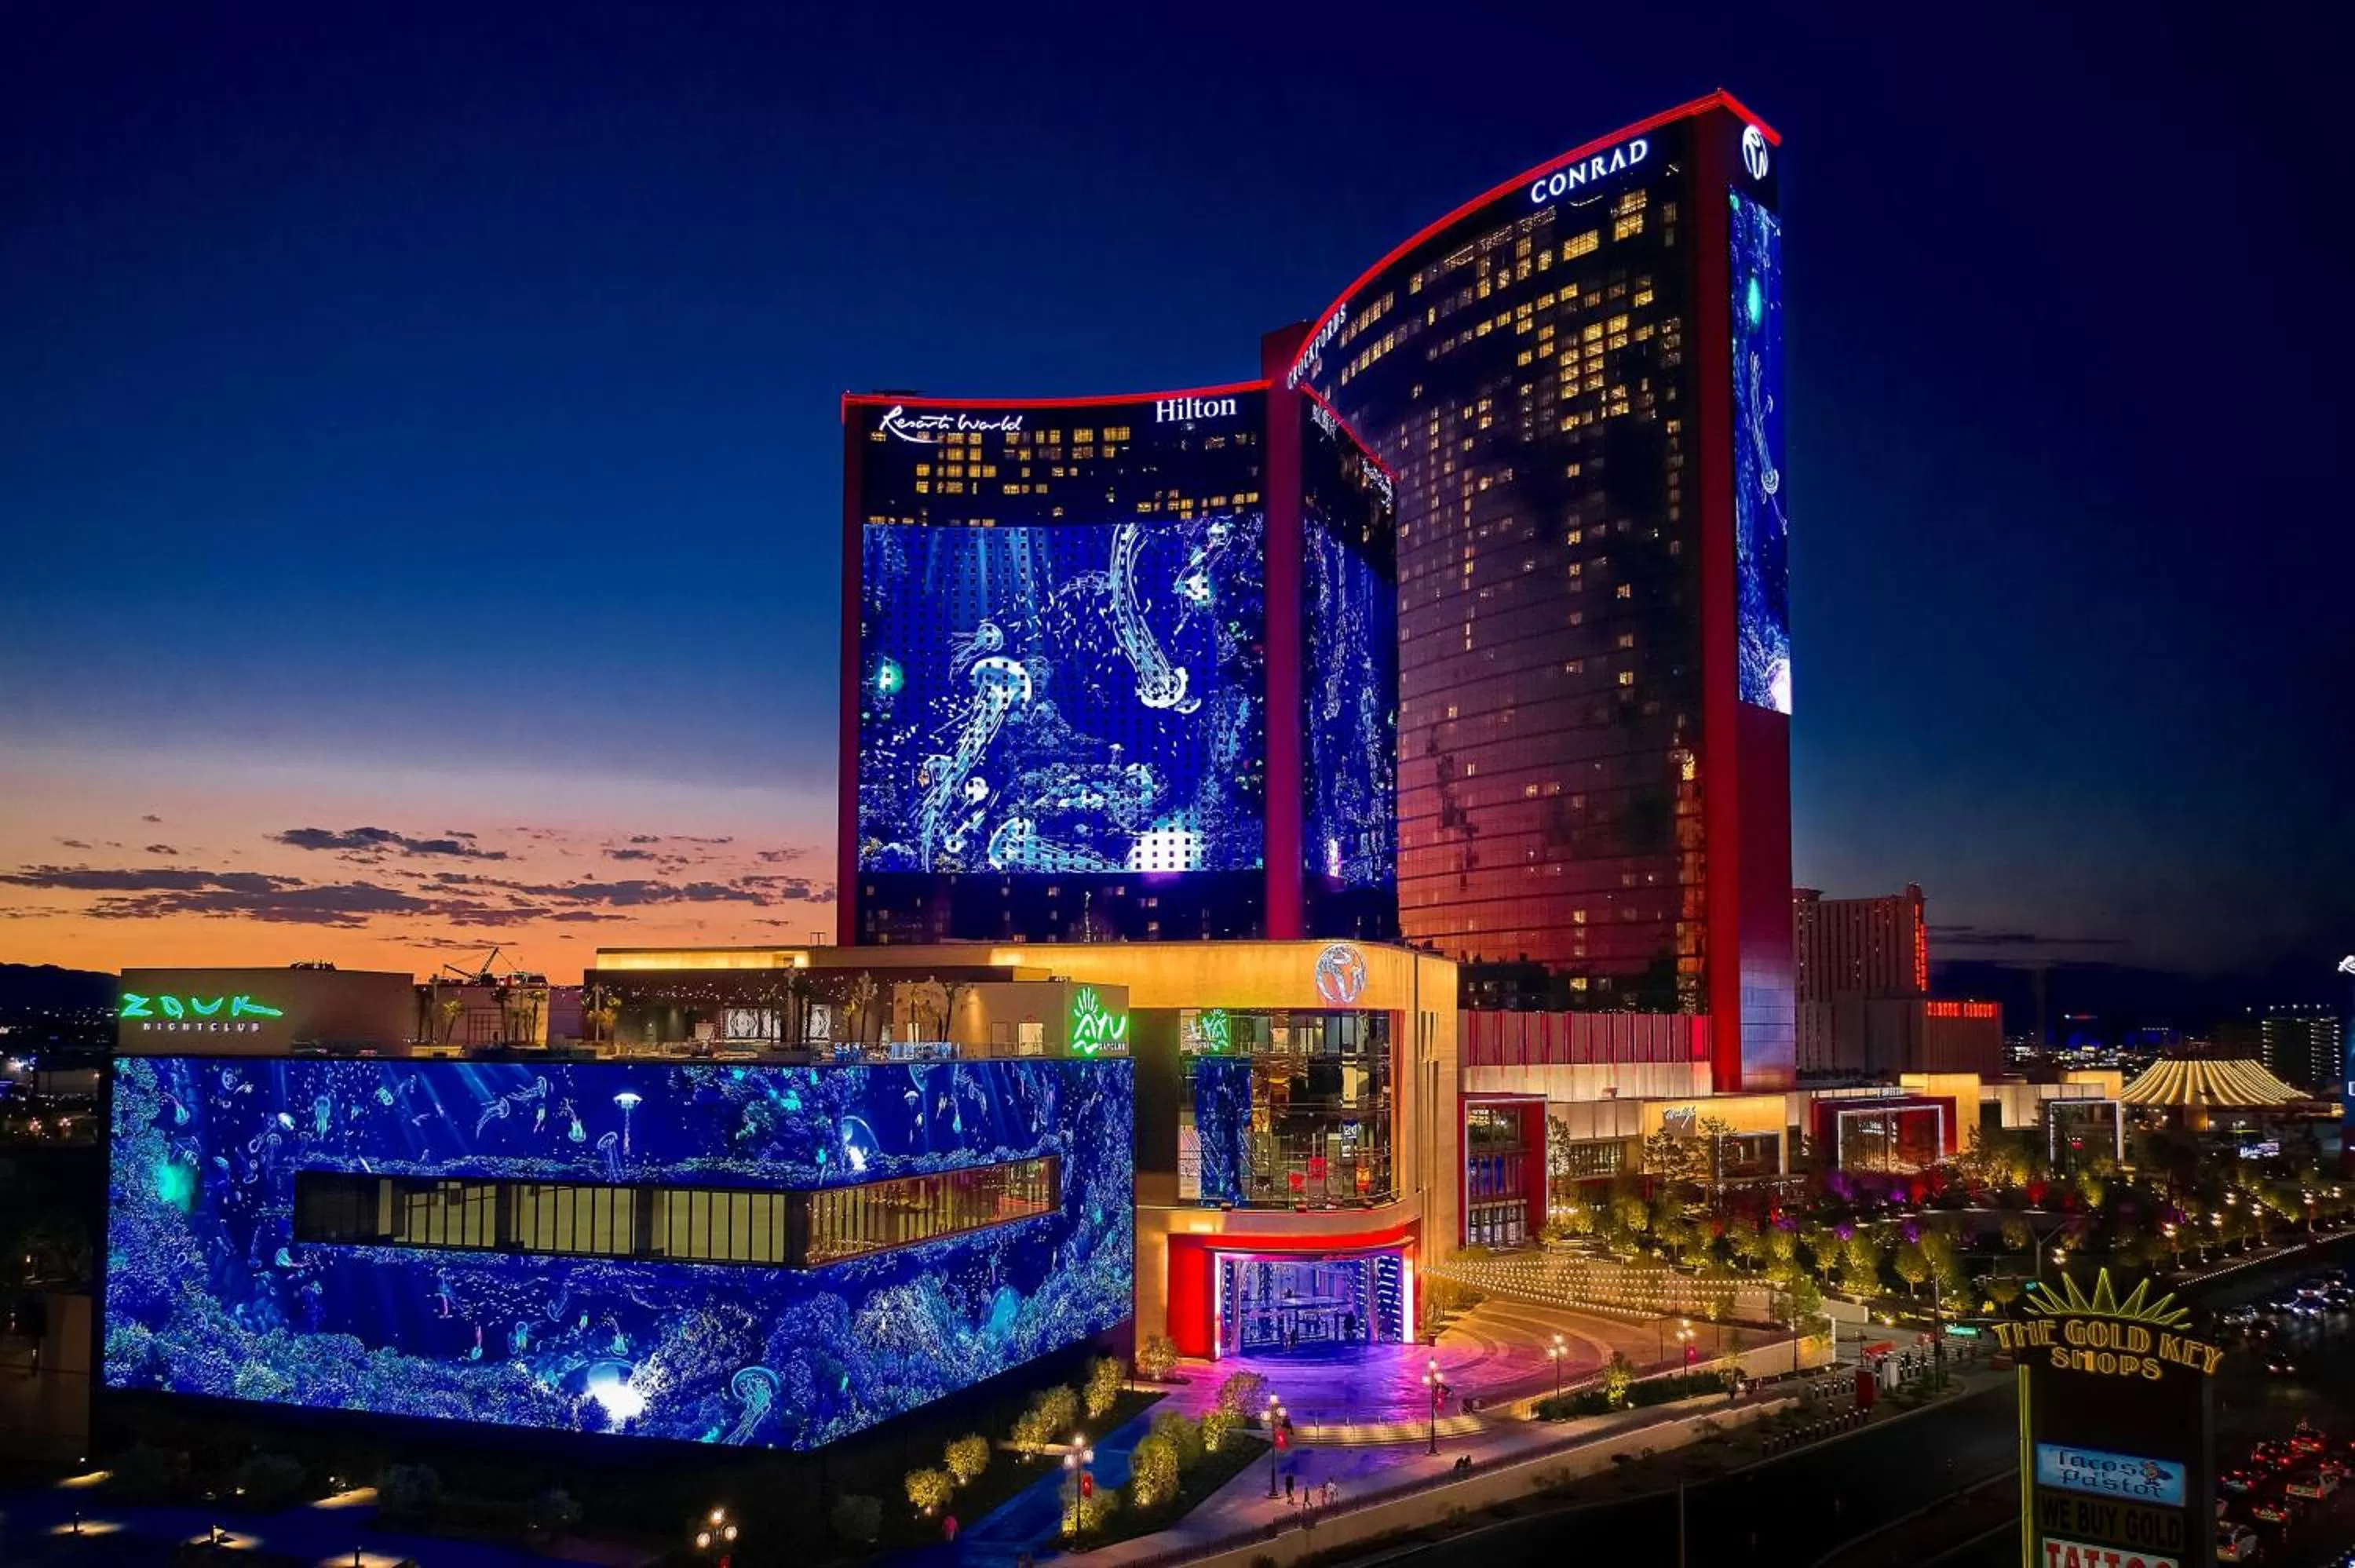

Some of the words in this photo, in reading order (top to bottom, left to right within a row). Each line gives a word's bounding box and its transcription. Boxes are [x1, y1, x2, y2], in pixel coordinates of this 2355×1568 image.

[1531, 139, 1648, 203] CONRAD
[878, 405, 954, 443] Resorts
[958, 414, 1023, 431] World
[1156, 396, 1237, 422] Hilton
[143, 1023, 261, 1031] NIGHTCLUB
[1992, 1319, 2057, 1351] THE
[2065, 1319, 2152, 1354] GOLD
[2159, 1333, 2225, 1374] KEY
[2050, 1346, 2163, 1381] SHOPS
[2043, 1494, 2071, 1530] WE
[2078, 1501, 2118, 1539] BUY
[2125, 1508, 2182, 1548] GOLD
[2046, 1543, 2171, 1568] TATT
